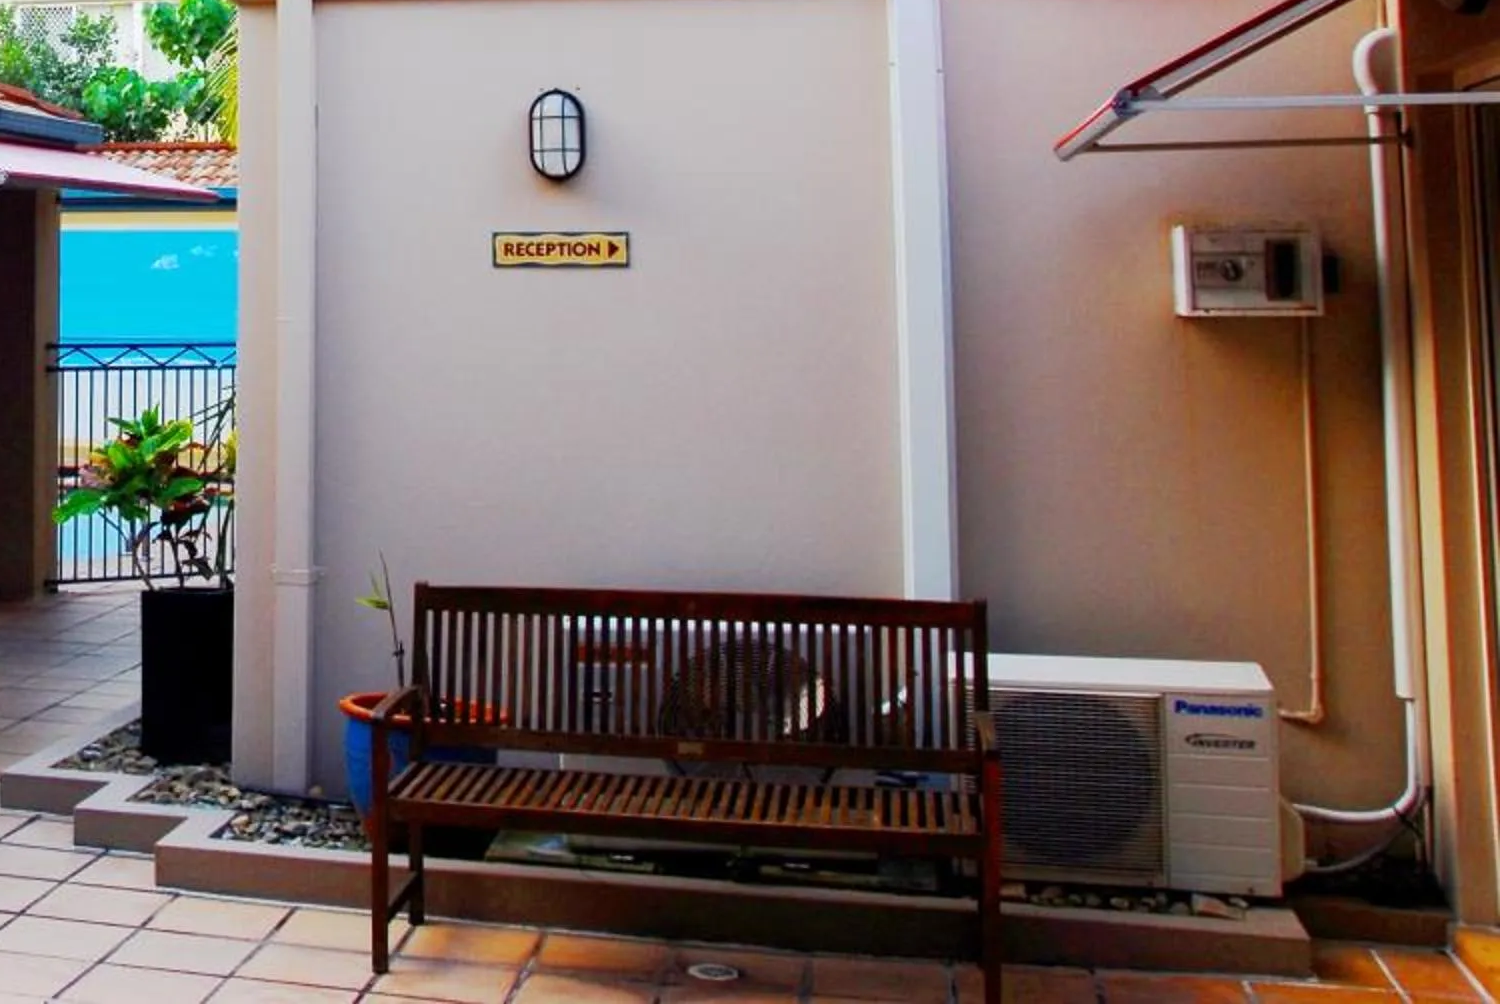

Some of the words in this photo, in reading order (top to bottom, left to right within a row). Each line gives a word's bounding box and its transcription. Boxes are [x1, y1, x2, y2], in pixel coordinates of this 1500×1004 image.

[503, 241, 601, 257] RECEPTION
[1173, 699, 1264, 718] Panasonic
[1186, 735, 1256, 750] INVERTER
